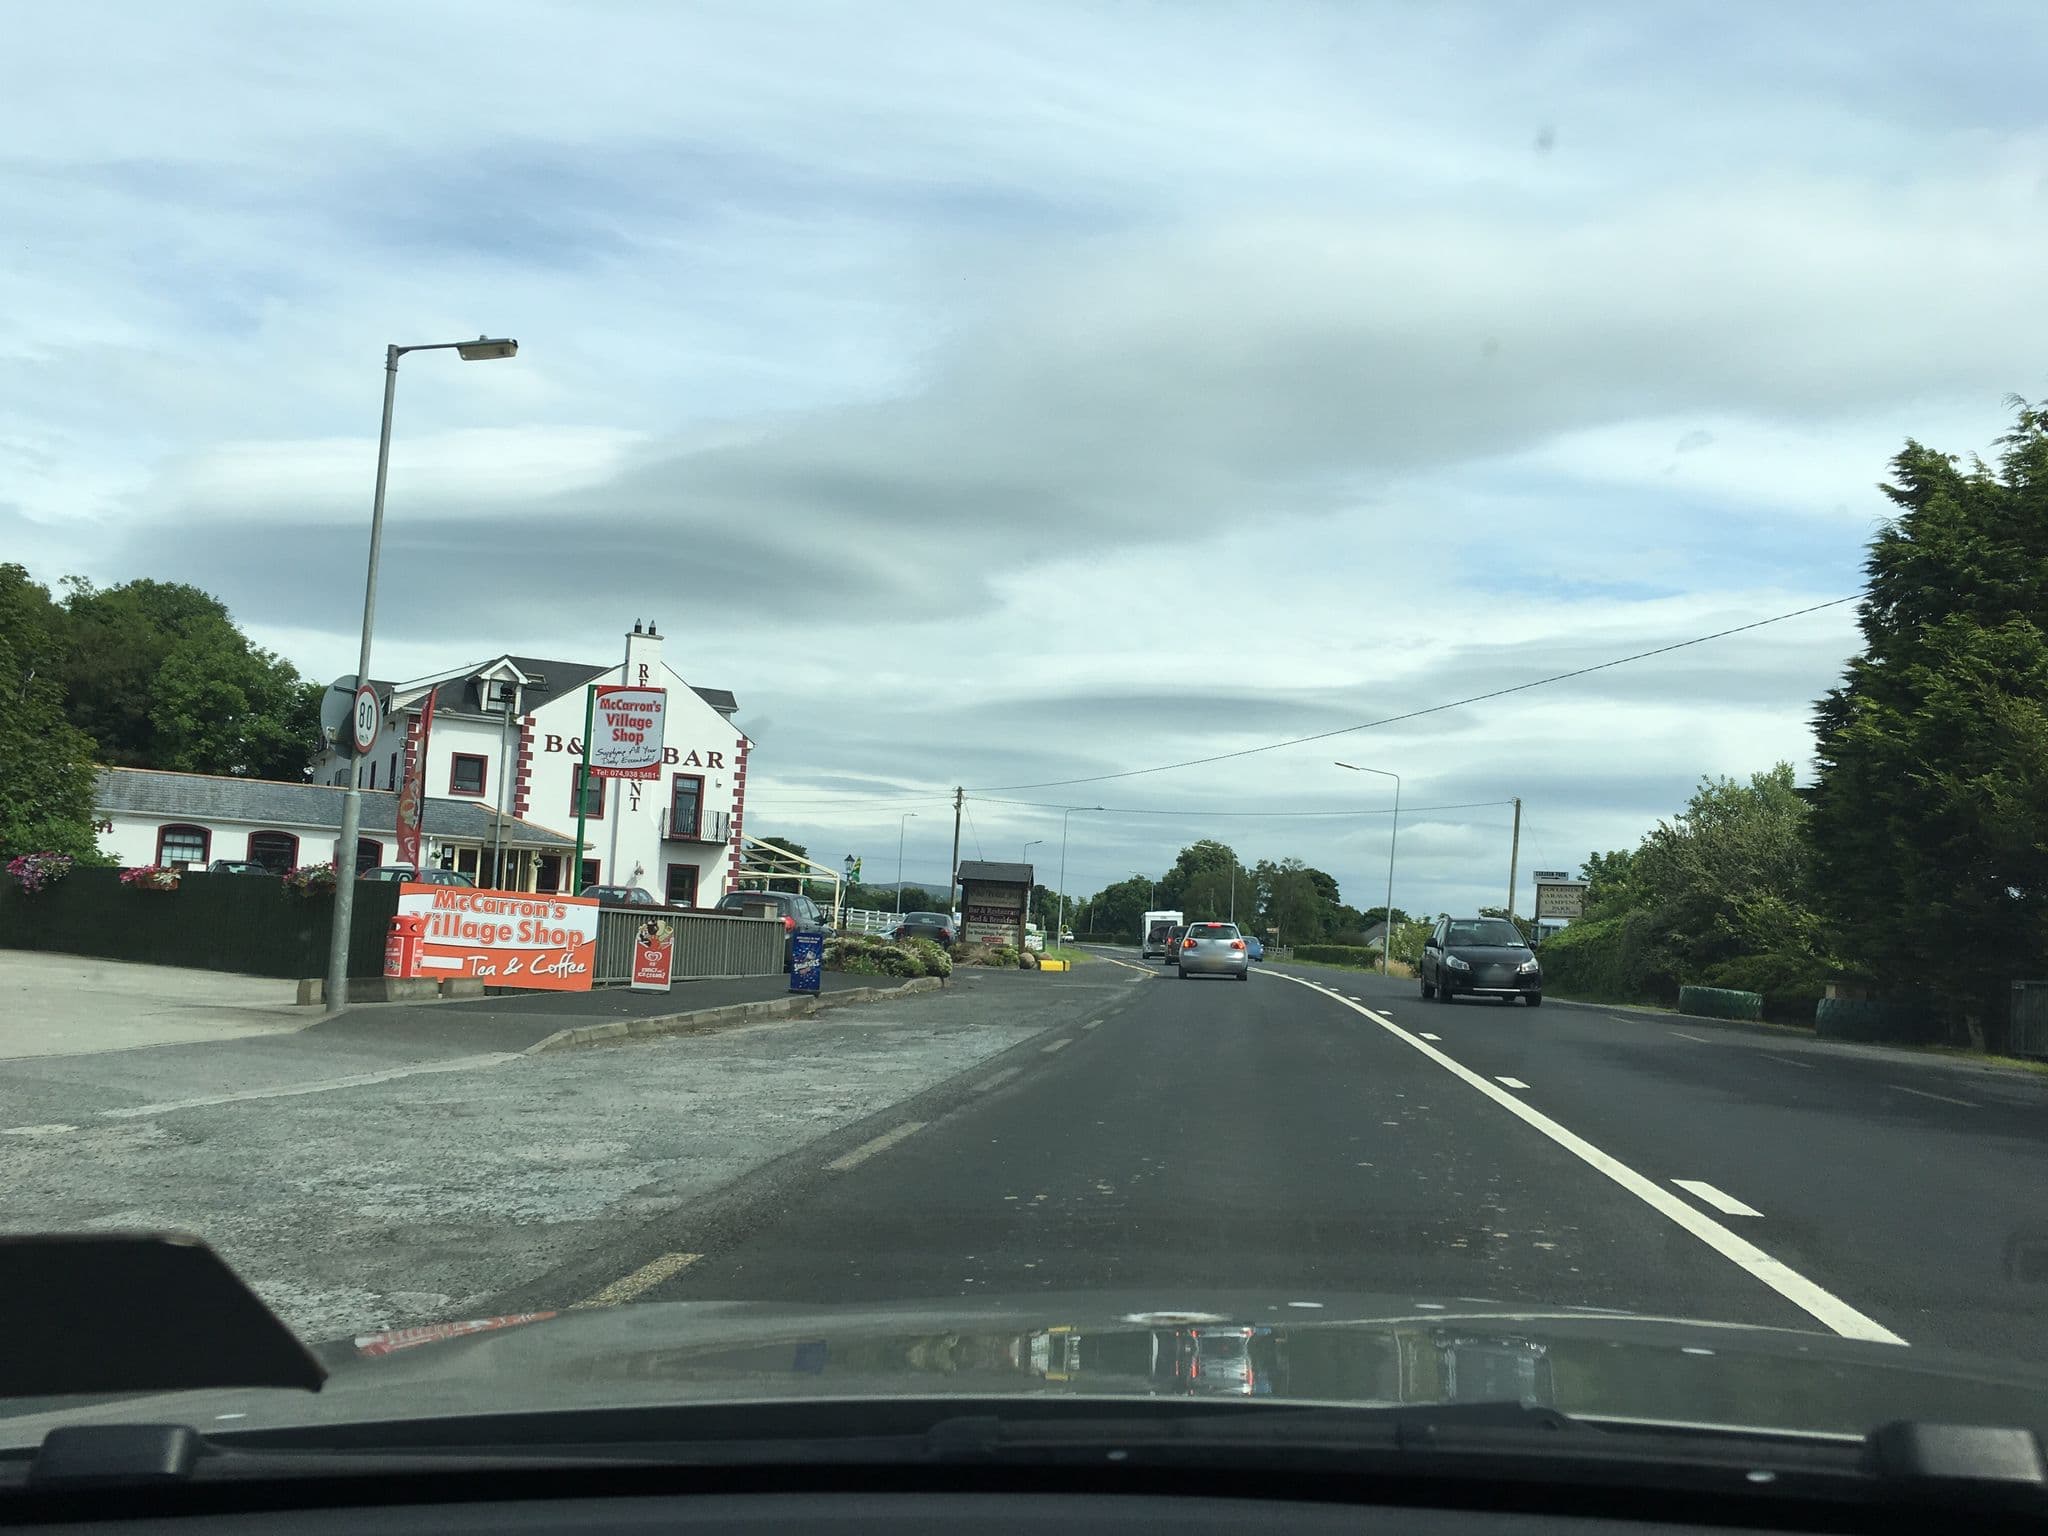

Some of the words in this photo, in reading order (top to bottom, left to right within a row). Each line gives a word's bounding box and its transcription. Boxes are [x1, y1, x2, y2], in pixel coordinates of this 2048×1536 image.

[359, 702, 373, 731] 80
[600, 698, 661, 713] McCarron's
[606, 713, 653, 731] Village
[612, 728, 645, 746] Shop
[662, 747, 725, 769] BAR
[596, 768, 609, 776] Tel:
[433, 890, 568, 920] McCarron's
[517, 920, 585, 952] Shop
[466, 955, 496, 977] Tea
[503, 957, 524, 976] &
[529, 952, 588, 979] Coffee
